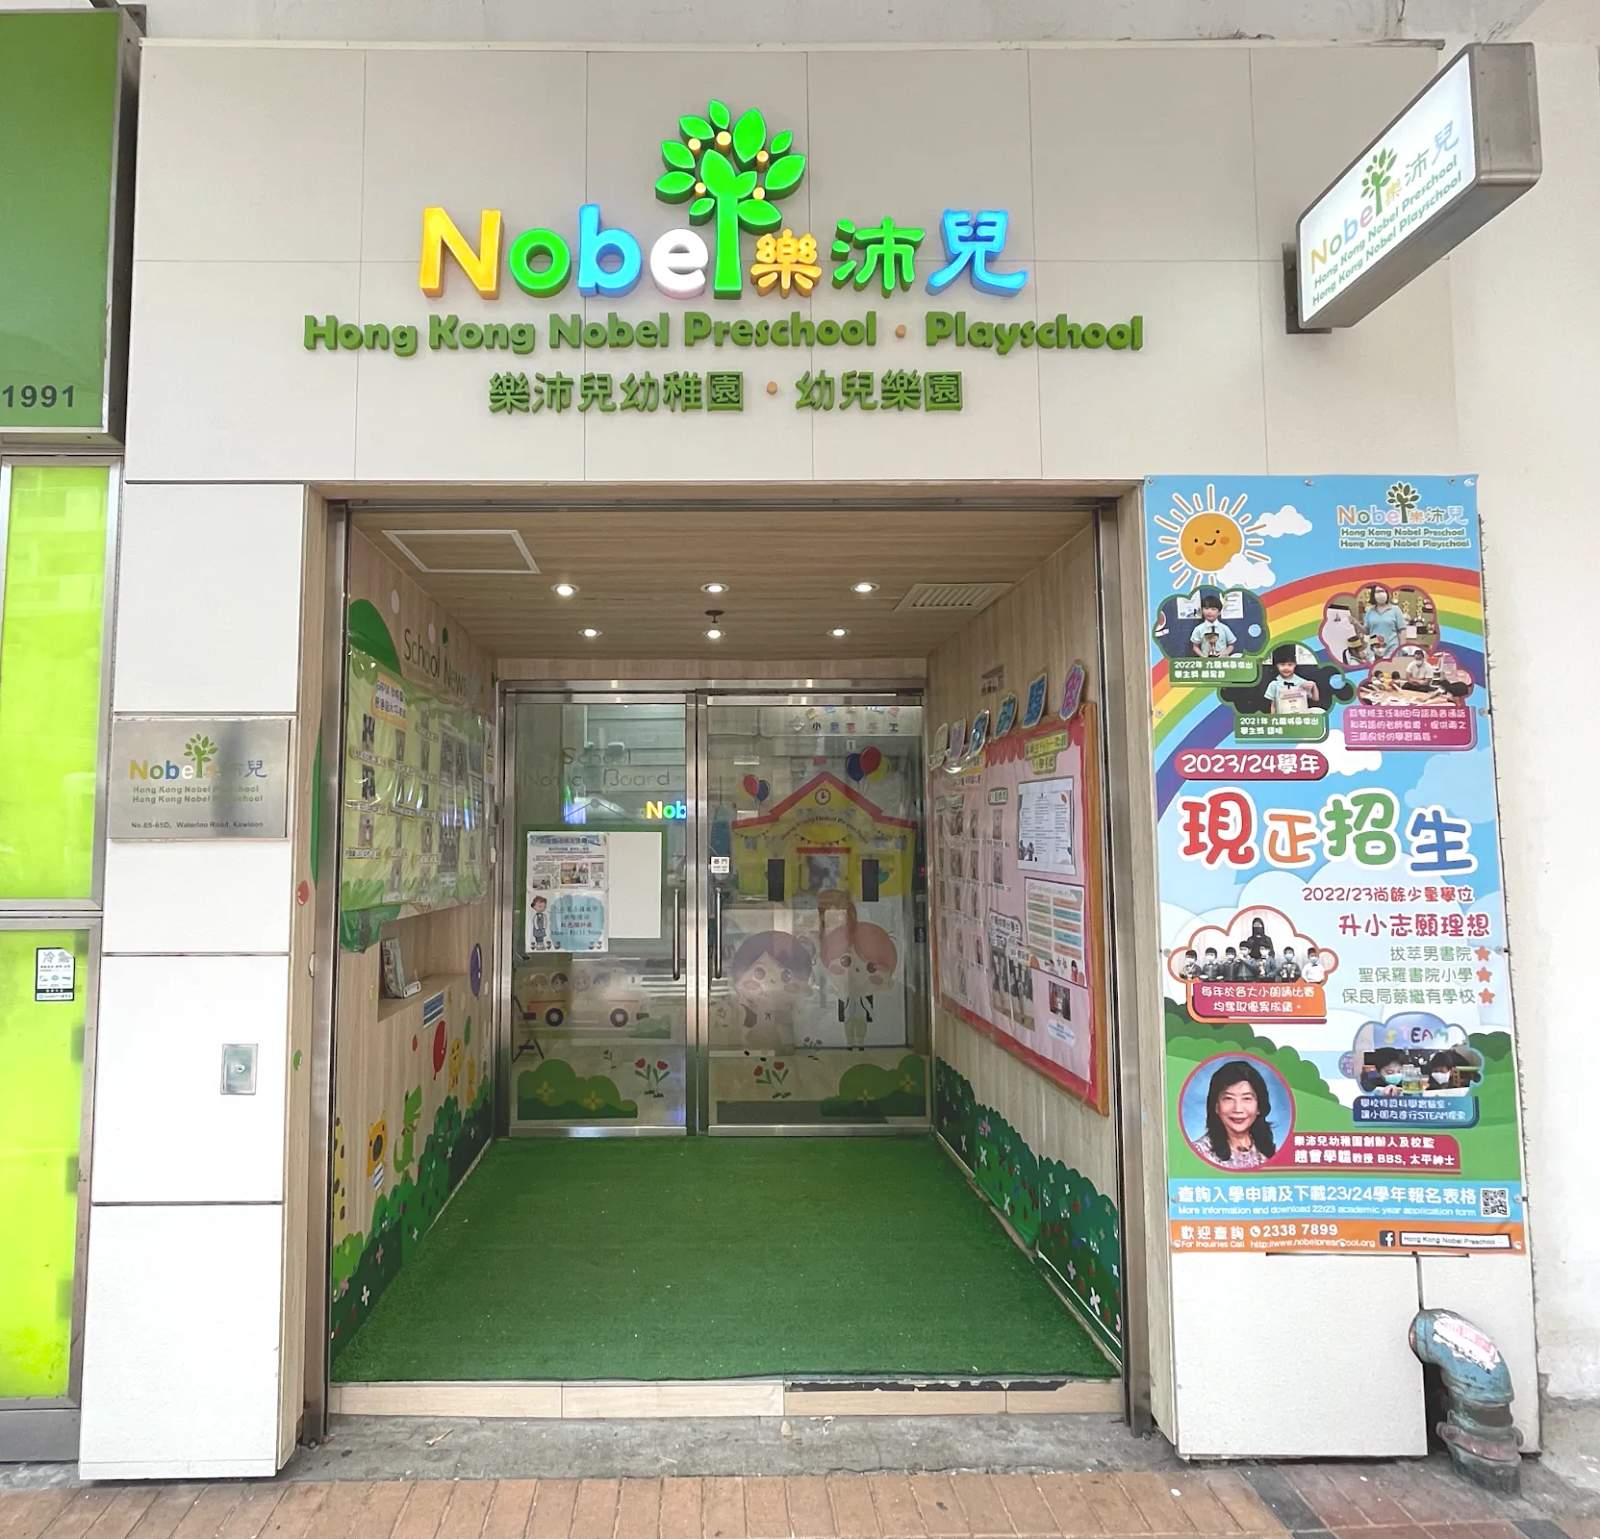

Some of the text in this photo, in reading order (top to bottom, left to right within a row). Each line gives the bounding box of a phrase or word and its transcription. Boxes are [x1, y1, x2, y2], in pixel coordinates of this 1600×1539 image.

[1314, 154, 1457, 289] Hong Kong Nobel Preschool
[1312, 171, 1462, 306] Hong Kong Nobel Playschool
[418, 203, 1029, 300] Nobel 樂沛兒
[304, 311, 1143, 357] Hong Kong Nobel Preschool Playschool
[3, 385, 74, 408] 1991
[489, 369, 963, 414] 樂沛兒幼稚園 幼兒樂園
[1341, 528, 1465, 537] Hong Kong Nobel Preschool
[1340, 539, 1470, 549] Hong Kong Nobel Playschool
[404, 628, 440, 678] School
[1182, 753, 1320, 774] 2023/24學年
[1181, 791, 1473, 873] 現正招生
[1303, 887, 1473, 902] 2022/23尚餘少量學位
[1338, 913, 1490, 937] 升小志願理想
[1390, 946, 1473, 961] 拔萃男書院
[1358, 967, 1473, 983] 聖保羅書院小學
[1342, 988, 1476, 1004] 保良局蔡繼有學校
[1377, 1154, 1406, 1165] BBS,
[1409, 1154, 1455, 1165] 太平紳士
[1177, 1185, 1476, 1205] 查詢入學申請及下載23/24學年報名表格
[1202, 1206, 1251, 1215] information
[1253, 1206, 1269, 1214] and
[1271, 1205, 1310, 1213] download
[1338, 1205, 1380, 1214] academic
[1382, 1207, 1401, 1215] year
[1403, 1206, 1453, 1216] application
[1455, 1208, 1477, 1216] form
[1180, 1225, 1244, 1240] 歡迎查詢
[1263, 1223, 1338, 1237] 2338 7899
[1181, 1240, 1245, 1249] For Inquiries Call
